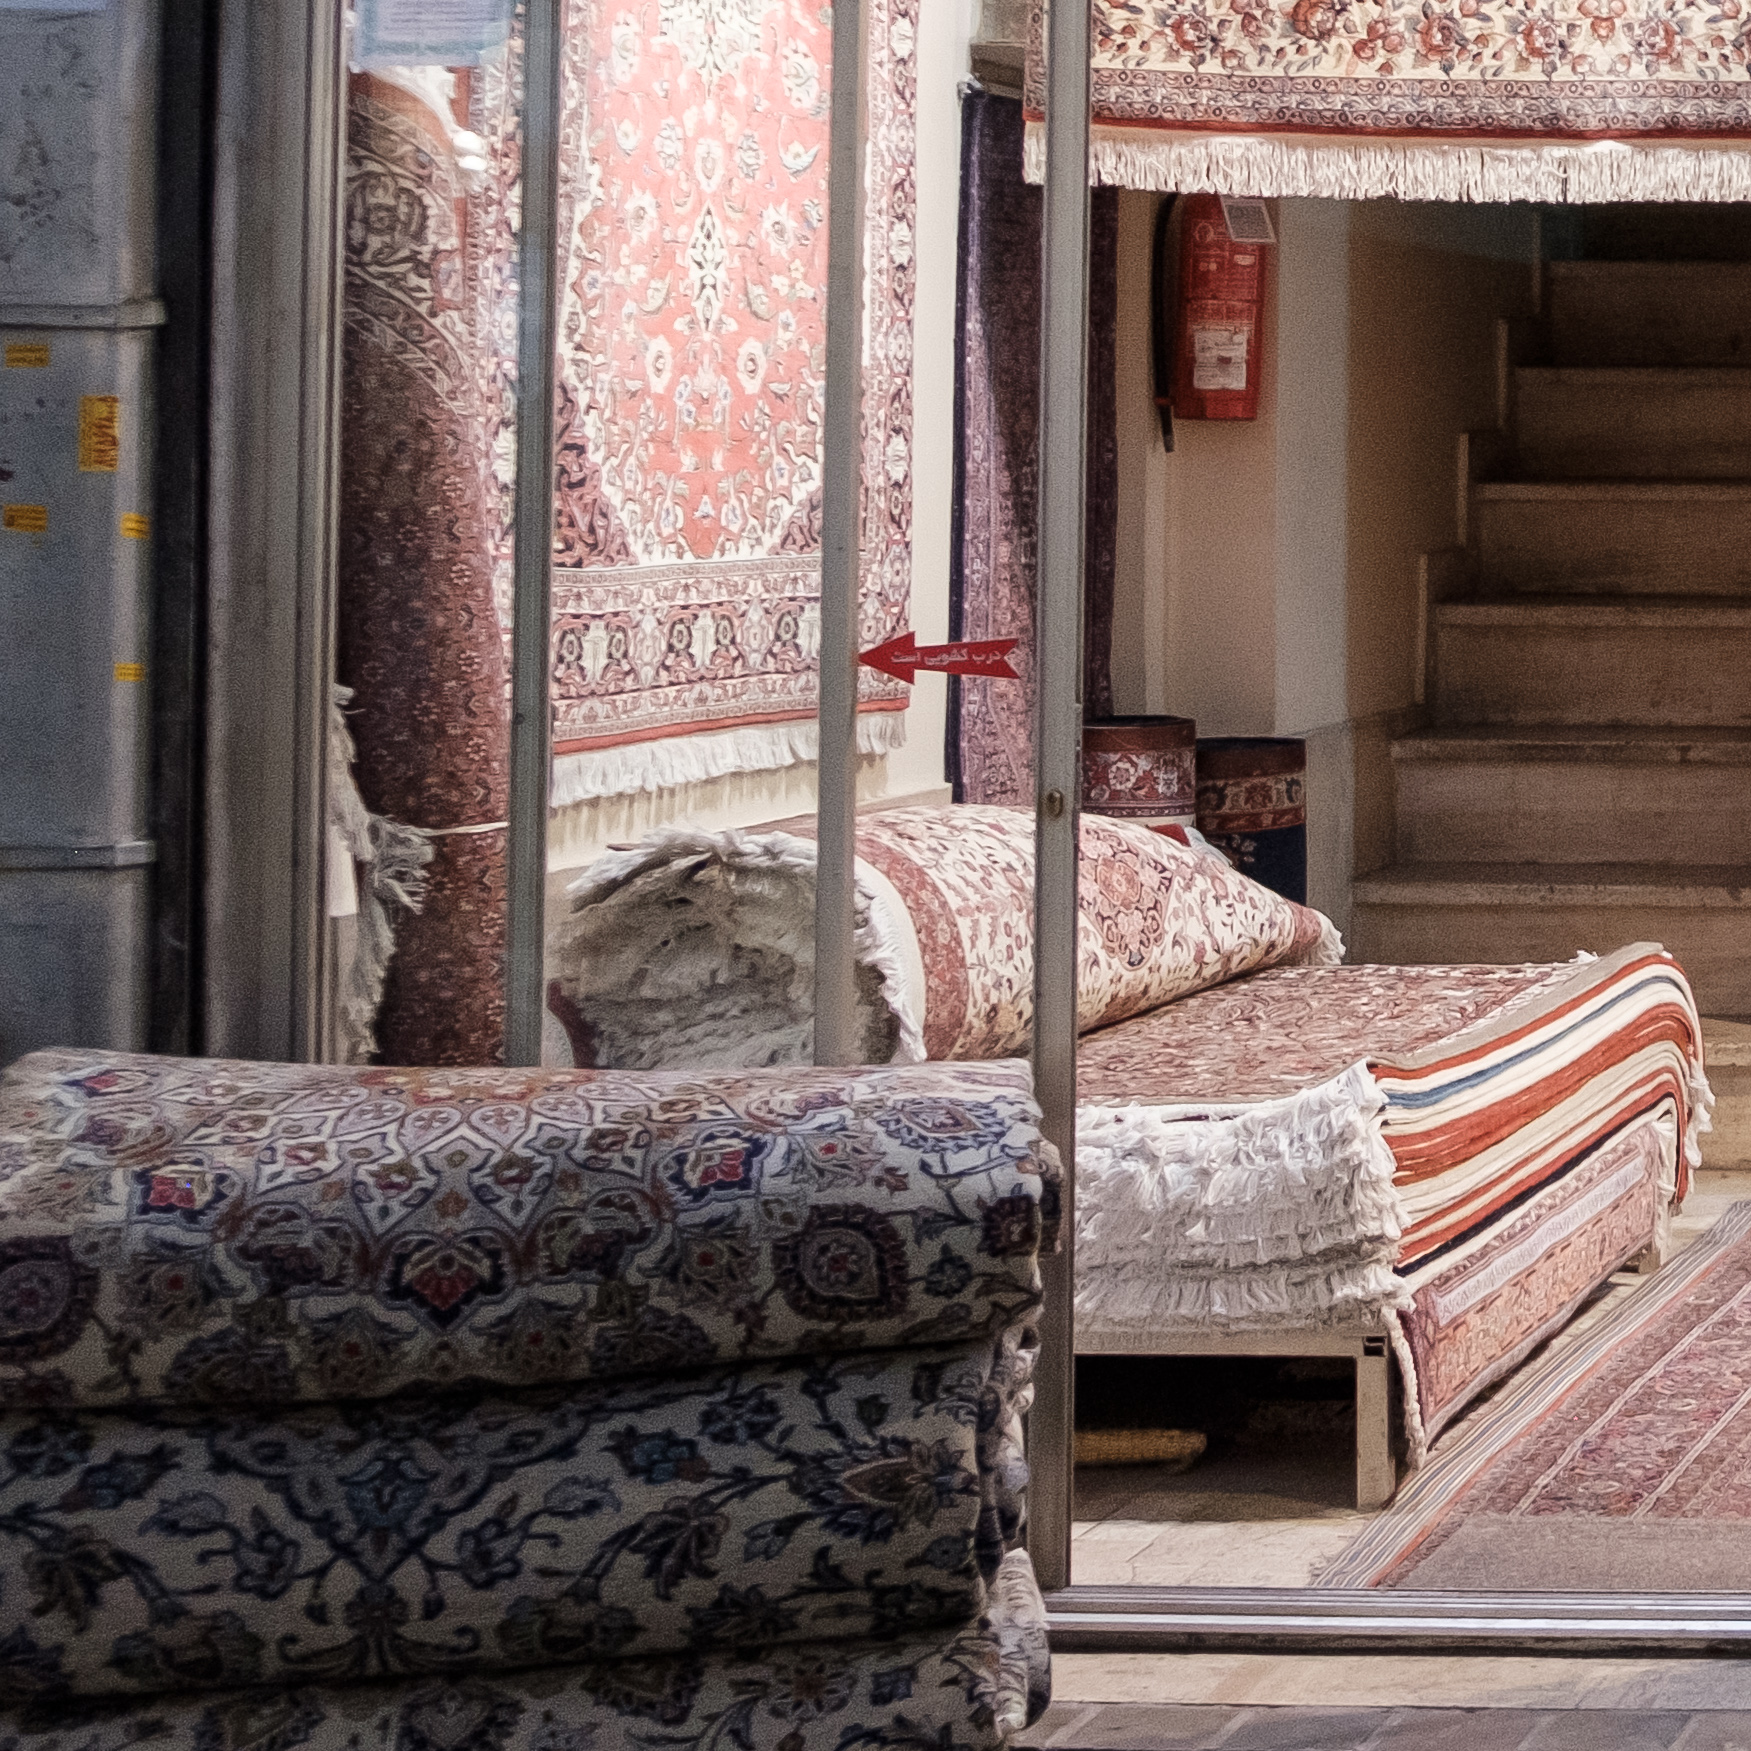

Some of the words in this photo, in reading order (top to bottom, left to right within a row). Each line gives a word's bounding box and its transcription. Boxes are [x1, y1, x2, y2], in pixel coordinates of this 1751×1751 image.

[891, 651, 921, 663] است
[924, 648, 969, 666] کشویی
[972, 650, 1001, 665] درب
